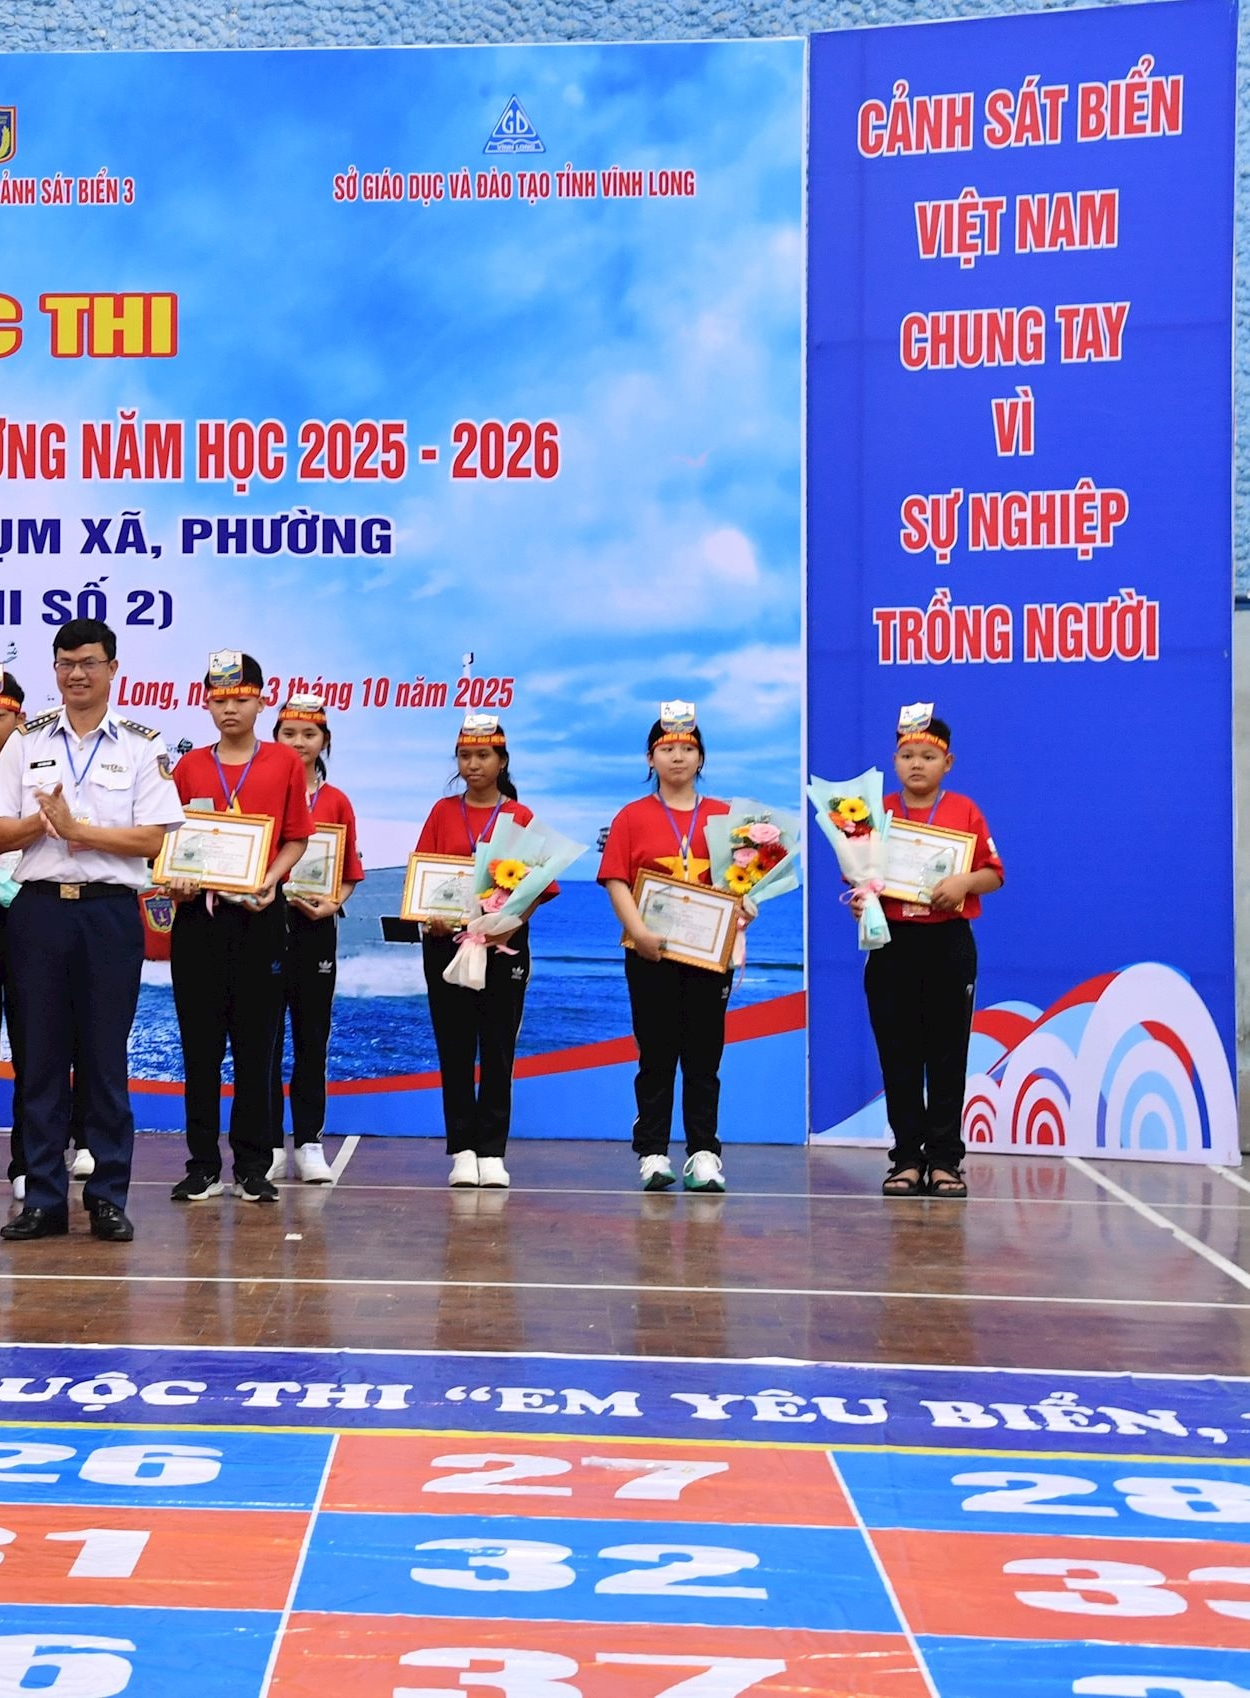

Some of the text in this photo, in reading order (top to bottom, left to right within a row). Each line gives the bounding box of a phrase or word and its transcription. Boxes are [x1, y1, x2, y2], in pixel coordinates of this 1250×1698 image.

[502, 109, 529, 134] GD
[859, 55, 1183, 157] CẢNH SÁT BIỂN
[41, 173, 73, 205] SÁT
[78, 168, 118, 204] BIỂN
[123, 178, 135, 204] 3
[334, 164, 696, 205] SỞ GIÁO DỤC VÀ ĐÀO TẠO TỈNH VĨNH LONG
[915, 188, 1119, 268] VIỆT NAM
[39, 293, 178, 358] THI
[901, 302, 1130, 371] CHUNG TAY
[81, 410, 183, 480] NĂM
[198, 421, 285, 493] HỌC
[300, 421, 406, 480] 2025
[451, 421, 560, 480] 2026
[991, 386, 1035, 456] VÌ
[80, 510, 162, 559] XÃ,
[182, 508, 392, 555] PHƯỜNG
[900, 478, 1130, 564] SỰ NGHIỆP
[41, 575, 110, 626] SỐ
[126, 589, 174, 630] 2)
[873, 588, 1159, 664] TRỒNG NGƯỜI
[117, 676, 179, 710] Long,
[263, 677, 281, 707] 3
[363, 678, 389, 708] 10
[396, 675, 451, 708] năm
[453, 677, 514, 708] 2025
[235, 1381, 413, 1411] THI
[444, 1385, 645, 1418] “EM
[669, 1389, 889, 1425] YÊU
[919, 1391, 1229, 1444] BIỂN,
[421, 1453, 730, 1501] 27
[950, 1470, 1250, 1523] 28
[410, 1538, 768, 1599] 32
[392, 1647, 787, 1698] 37
